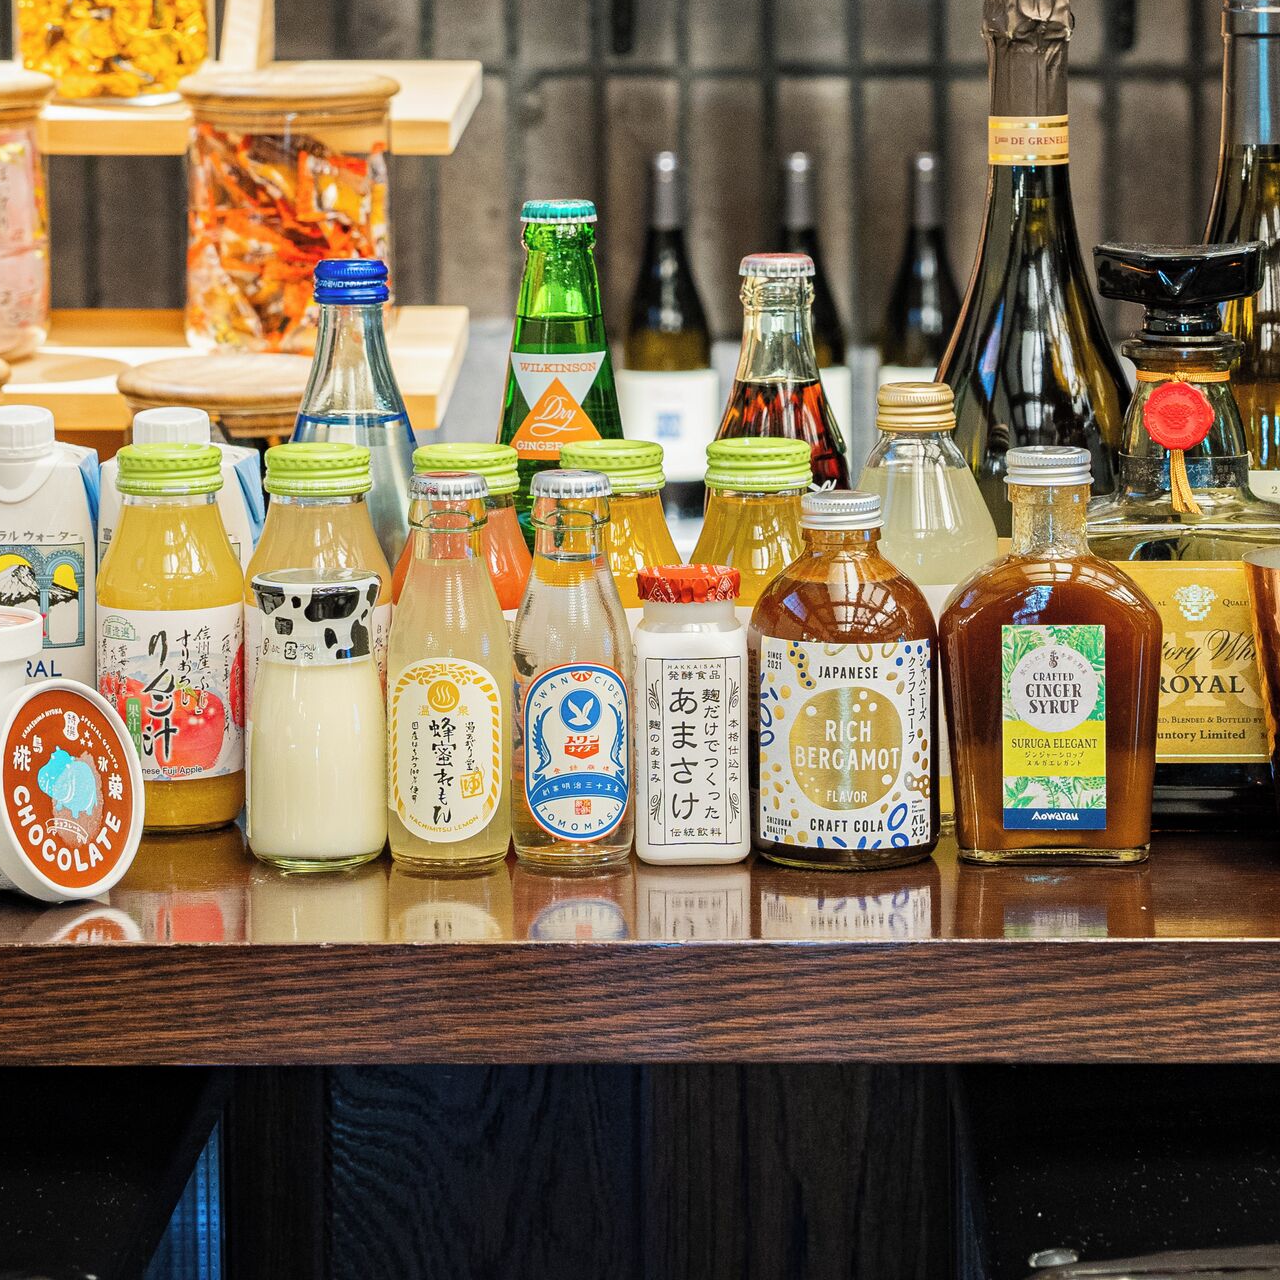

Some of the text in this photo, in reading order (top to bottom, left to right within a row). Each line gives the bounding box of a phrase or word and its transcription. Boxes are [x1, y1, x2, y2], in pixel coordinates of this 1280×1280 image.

[1011, 136, 1025, 145] DE
[520, 362, 597, 373] WILKINSON
[530, 395, 582, 437] Dry
[767, 651, 783, 660] SINCE
[767, 660, 782, 670] 2021
[818, 666, 879, 679] JAPANESE
[667, 669, 722, 681] 発酵食品
[1033, 672, 1075, 682] CRAFTED
[533, 675, 624, 709] SWAN CIDER
[917, 653, 927, 721] ジャパニーズ
[1025, 683, 1082, 698] GINGER
[142, 629, 181, 761] りんご汁
[907, 656, 917, 745] クラフトコーラ
[1029, 699, 1080, 714] SYRUP
[1171, 715, 1205, 724] BLENDED
[1216, 715, 1251, 724] BOTTLED
[825, 719, 871, 742] RICH
[1157, 729, 1246, 742] untory Limited
[80, 715, 119, 769] SPECIAL GELATO
[565, 735, 600, 744] スワン
[1011, 738, 1098, 749] SURUGA ELEGANT
[567, 744, 598, 753] サイダー
[648, 719, 662, 783] 麹のあまみ
[669, 687, 700, 821] あまさけ
[701, 688, 721, 820] 麹だけでつくった
[727, 719, 739, 782] 本格仕込み
[794, 747, 900, 771] BERGAMOT
[162, 765, 178, 776] Fuji
[180, 765, 203, 776] Apple
[428, 716, 457, 826] 蜂蜜れもん
[826, 790, 868, 803] FLAVOR
[409, 813, 479, 833] HACHIMITSU LEMON
[539, 803, 621, 831] TOMOMASU
[766, 815, 792, 828] SHIZUOKA
[13, 785, 122, 872] CHOCOLATE
[670, 826, 722, 838] 伝統飲料
[766, 825, 788, 836] QUALITY
[809, 818, 884, 833] CRAFT COLA
